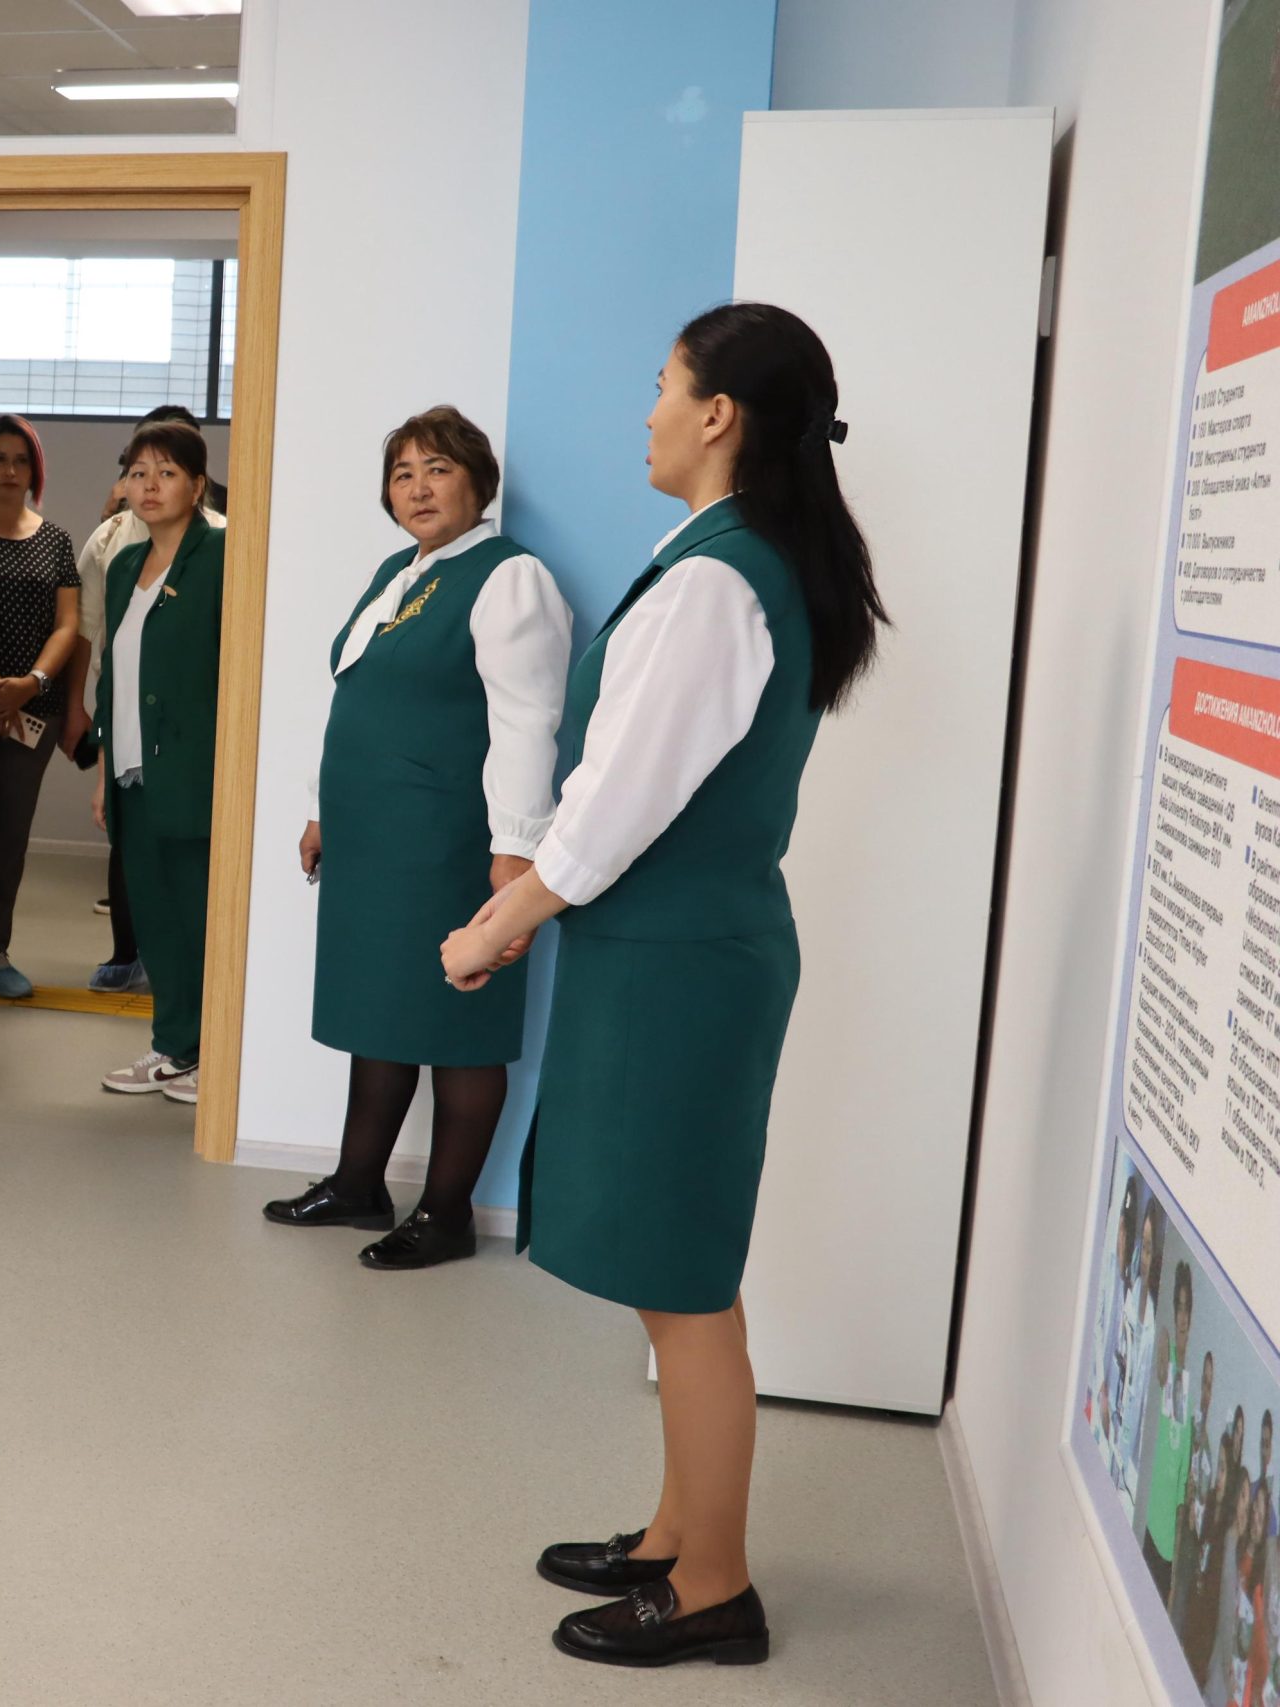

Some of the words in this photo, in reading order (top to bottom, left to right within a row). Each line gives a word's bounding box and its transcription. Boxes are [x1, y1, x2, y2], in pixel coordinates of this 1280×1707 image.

[1217, 385, 1245, 406] Студентов
[1207, 419, 1232, 436] Мастеров
[1232, 414, 1251, 431] спорта
[1204, 448, 1237, 466] Иностранных
[1237, 442, 1266, 462] студентов
[1201, 476, 1234, 495] Обладателей
[1234, 477, 1250, 492] знака
[1202, 533, 1235, 552] Выпускников
[1192, 562, 1218, 581] Договоров
[1222, 567, 1266, 584] сотрудничестве
[1195, 692, 1239, 723] ДОСТИЖЕНИЯ
[1168, 753, 1204, 779] международном
[1203, 768, 1228, 791] рейтинге
[1178, 781, 1197, 801] учебных
[1196, 792, 1224, 815] заведений
[1258, 790, 1280, 818] Greenm
[1168, 797, 1189, 826] University
[1212, 821, 1223, 842] ВКУ
[1255, 821, 1273, 843] вузов
[1187, 837, 1211, 860] занимает
[1251, 850, 1257, 870] В
[1248, 879, 1280, 917] образоват
[1185, 913, 1205, 937] рейтинг
[1201, 899, 1223, 926] впервые
[1239, 962, 1260, 990] списке
[1260, 974, 1274, 1000] ВКУ
[1176, 984, 1198, 1015] рейтинге
[1237, 989, 1265, 1023] занимает
[1265, 1010, 1275, 1032] 47
[1199, 1034, 1215, 1059] вузов
[1238, 1027, 1265, 1063] рейтинге
[1227, 1075, 1246, 1103] вошли
[1225, 1097, 1232, 1118] 11
[1221, 1127, 1240, 1158] вошли
